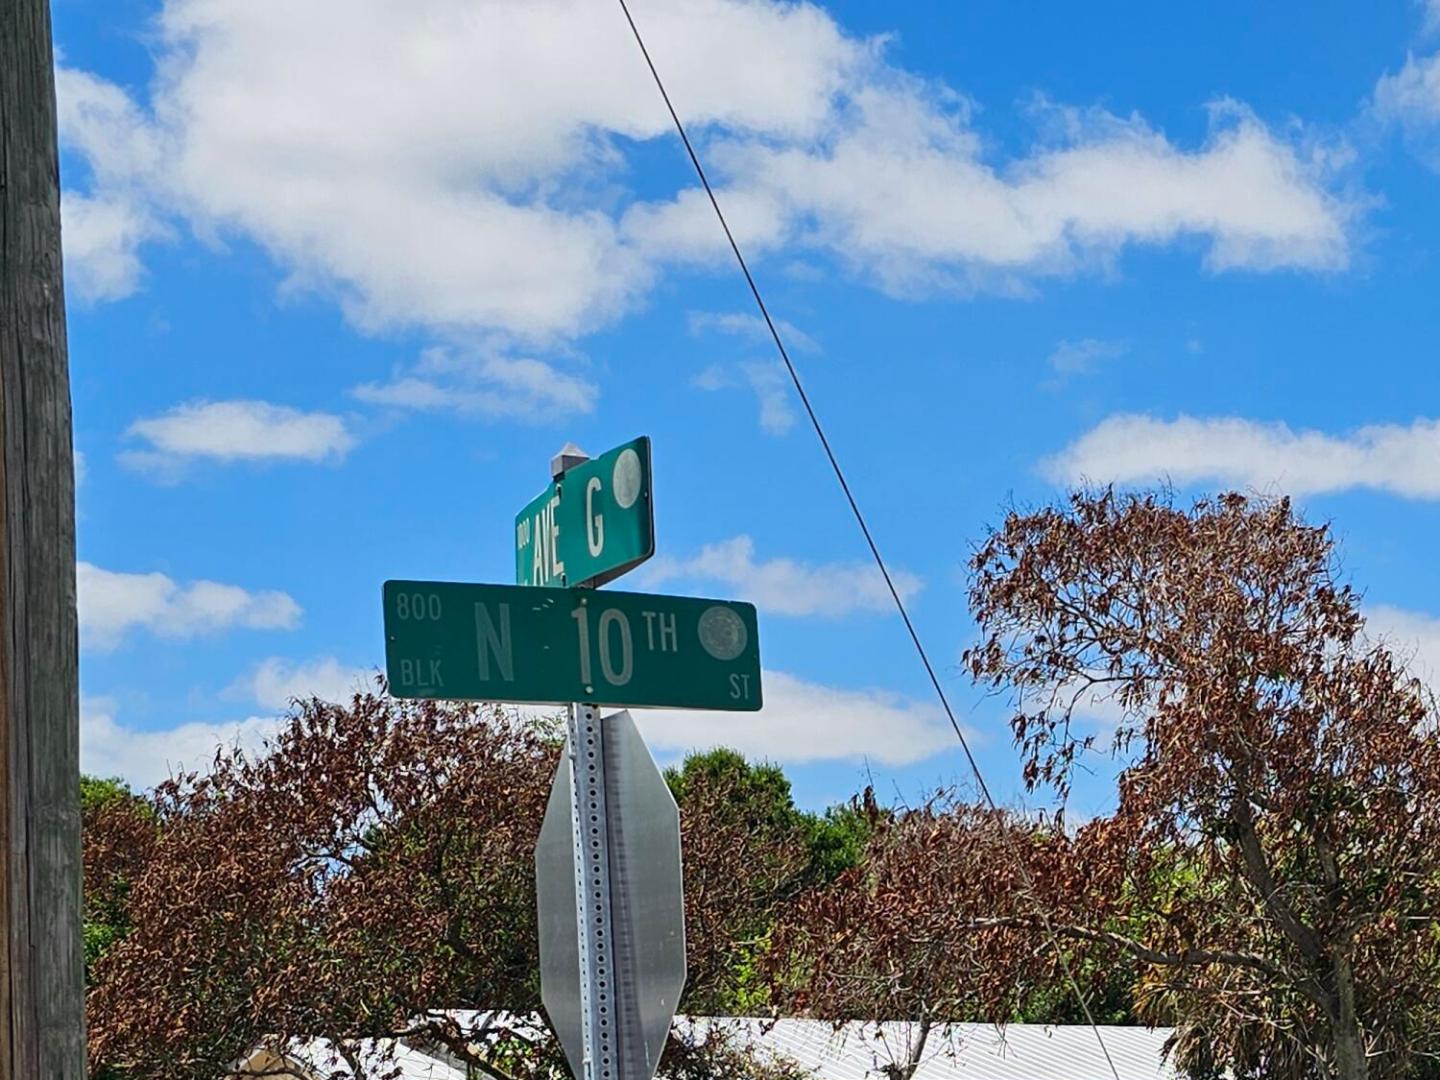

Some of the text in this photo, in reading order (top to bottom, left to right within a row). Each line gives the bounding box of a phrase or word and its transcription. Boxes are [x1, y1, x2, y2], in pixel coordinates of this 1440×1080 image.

[533, 476, 604, 586] AVE G
[397, 592, 442, 620] 800
[401, 659, 444, 687] BLK
[474, 602, 514, 682] N
[729, 673, 750, 700] ST
